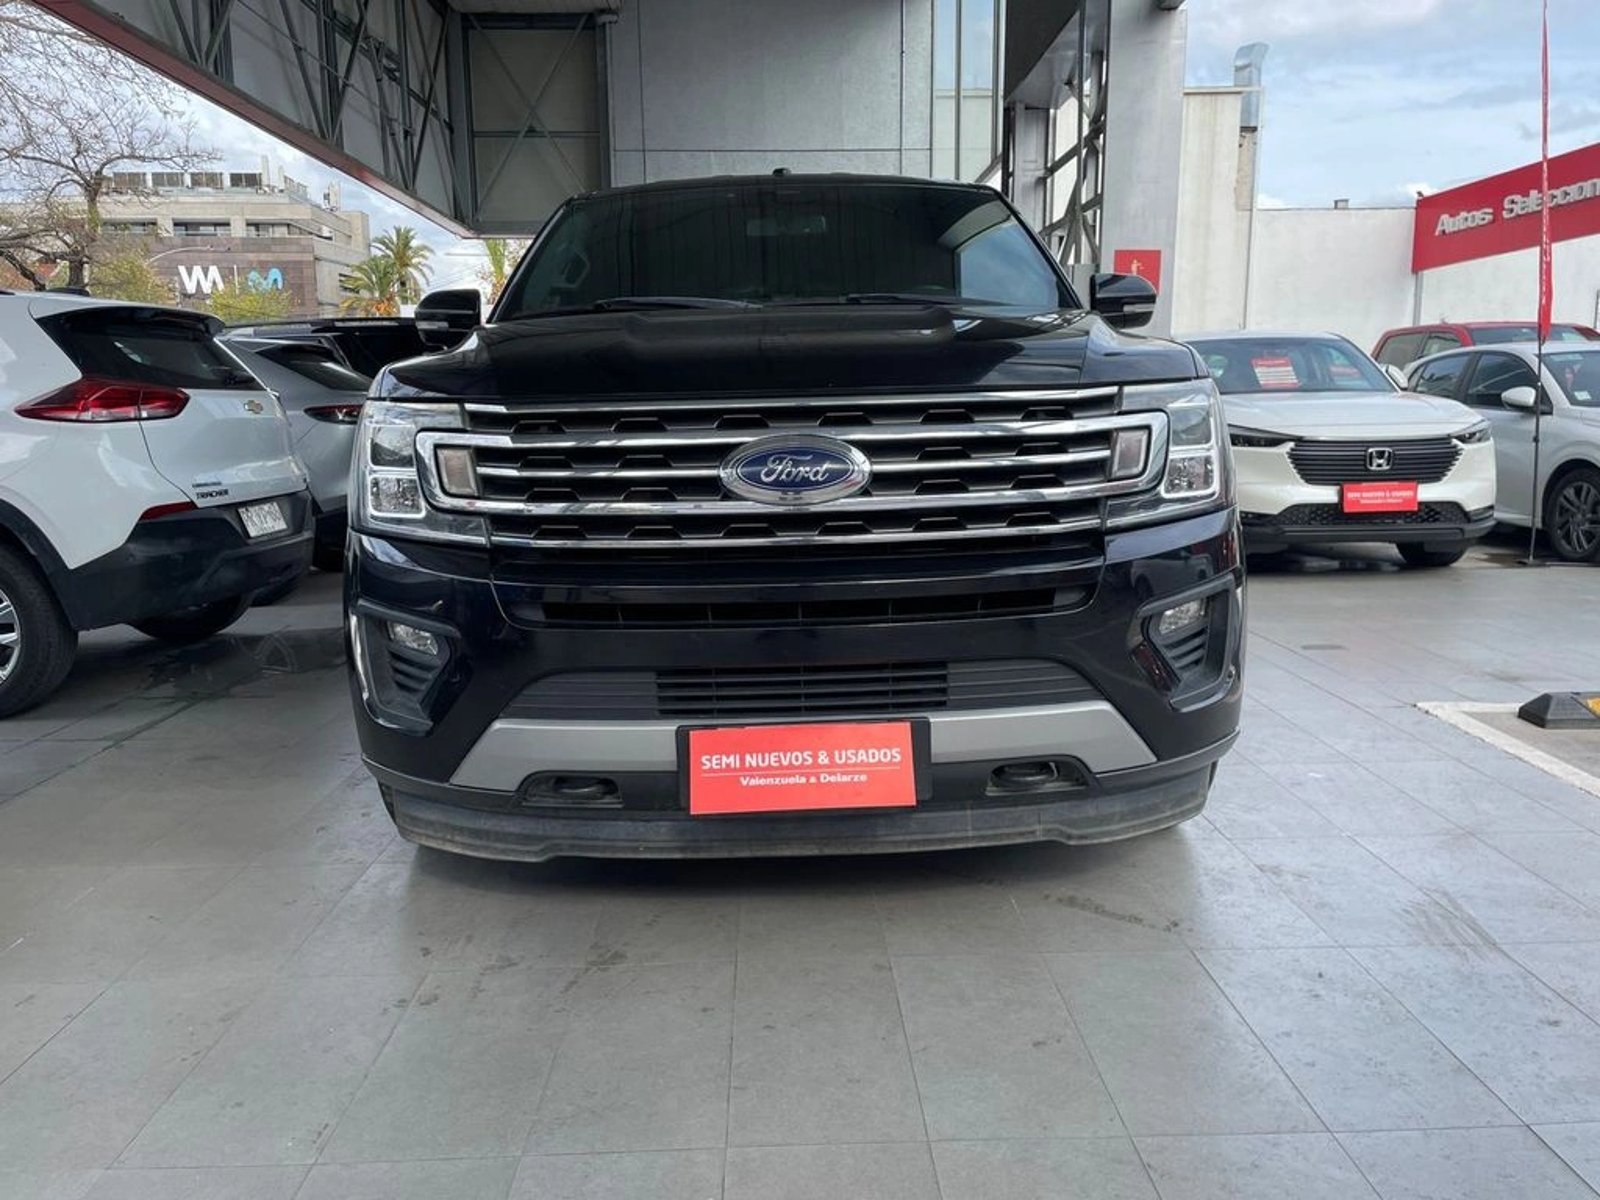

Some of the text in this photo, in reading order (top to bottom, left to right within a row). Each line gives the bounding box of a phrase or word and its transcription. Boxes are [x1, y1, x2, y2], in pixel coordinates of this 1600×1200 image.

[1435, 207, 1493, 236] Autos
[760, 454, 829, 482] Ford
[701, 748, 901, 770] SEMI NUEVOS & USADOS
[740, 774, 806, 787] Valenzuela
[820, 773, 867, 784] Delarze
